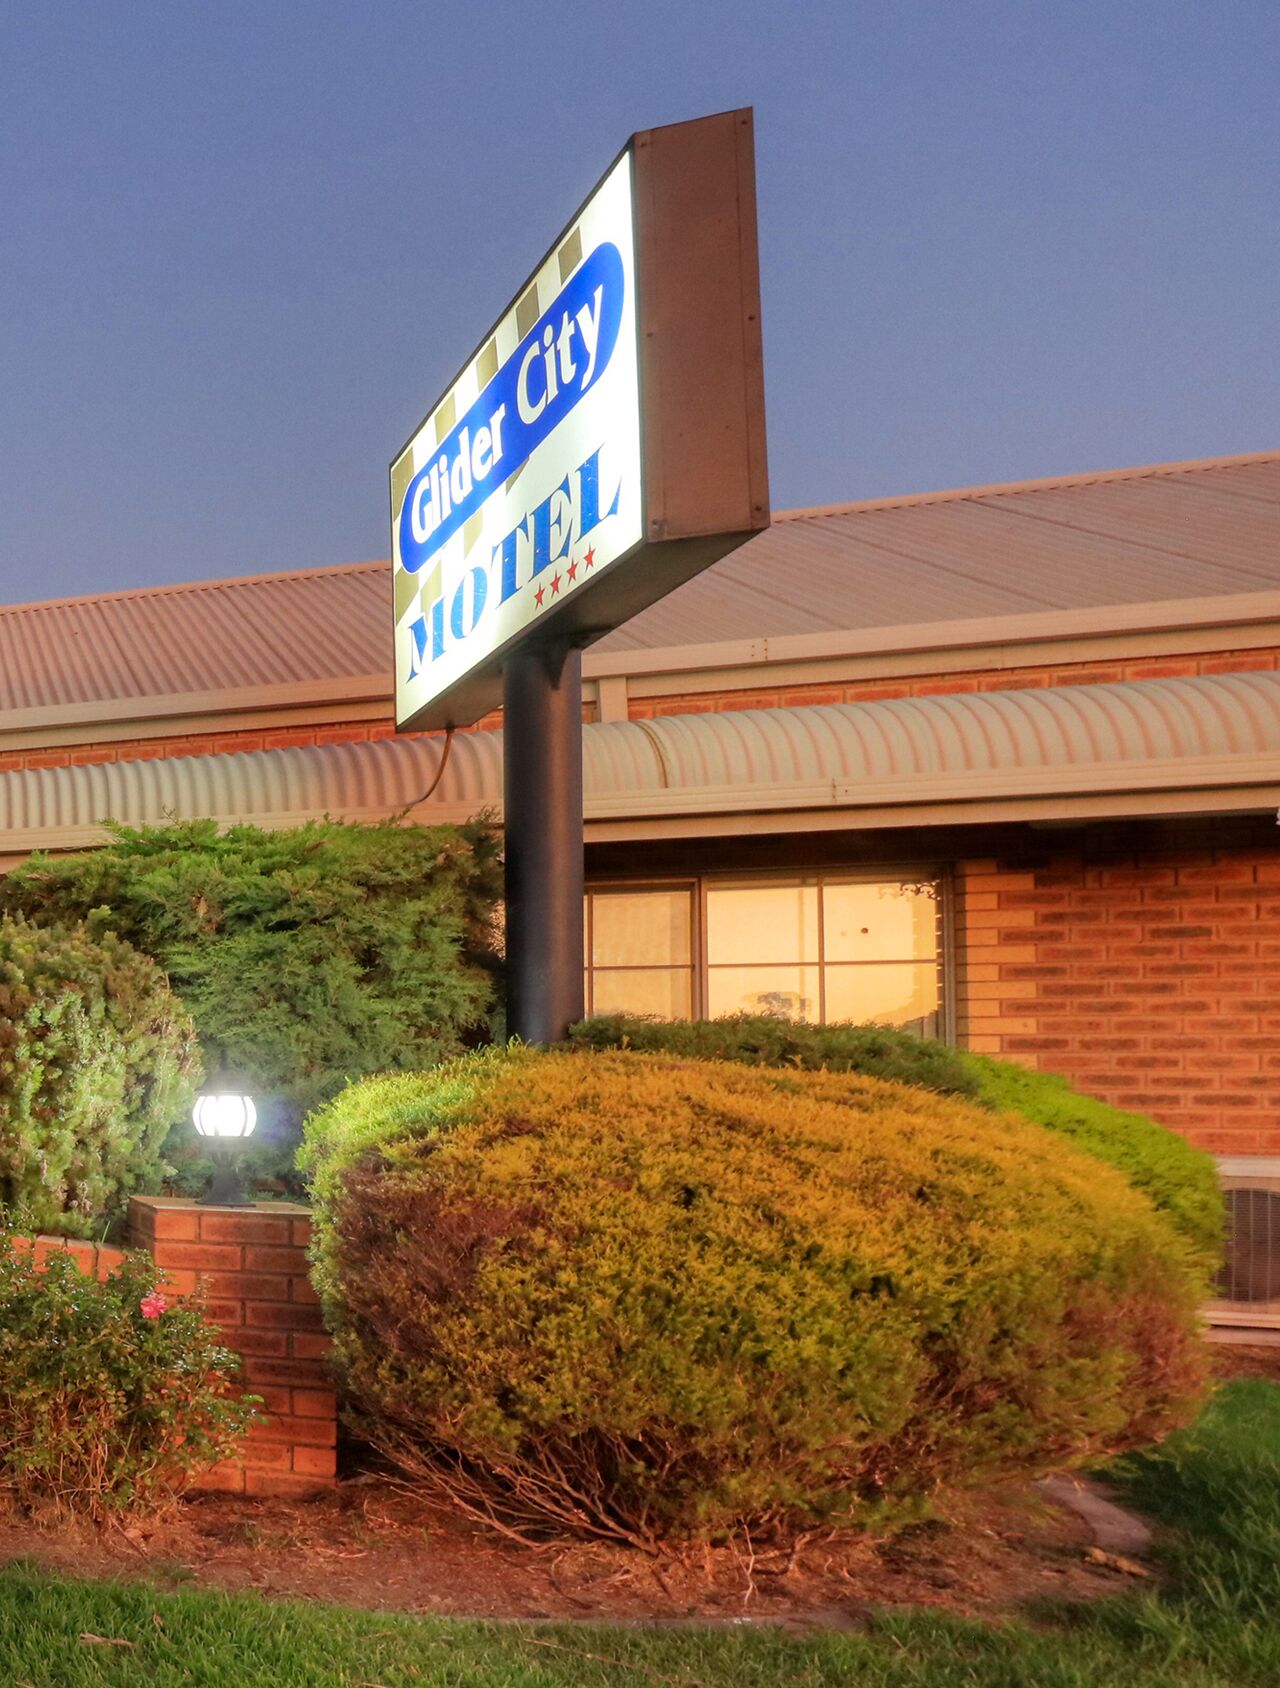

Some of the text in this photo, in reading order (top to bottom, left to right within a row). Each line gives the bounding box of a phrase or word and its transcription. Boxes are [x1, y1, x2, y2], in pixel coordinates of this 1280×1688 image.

[411, 283, 604, 544] Glider City
[406, 441, 622, 683] MOTEL
